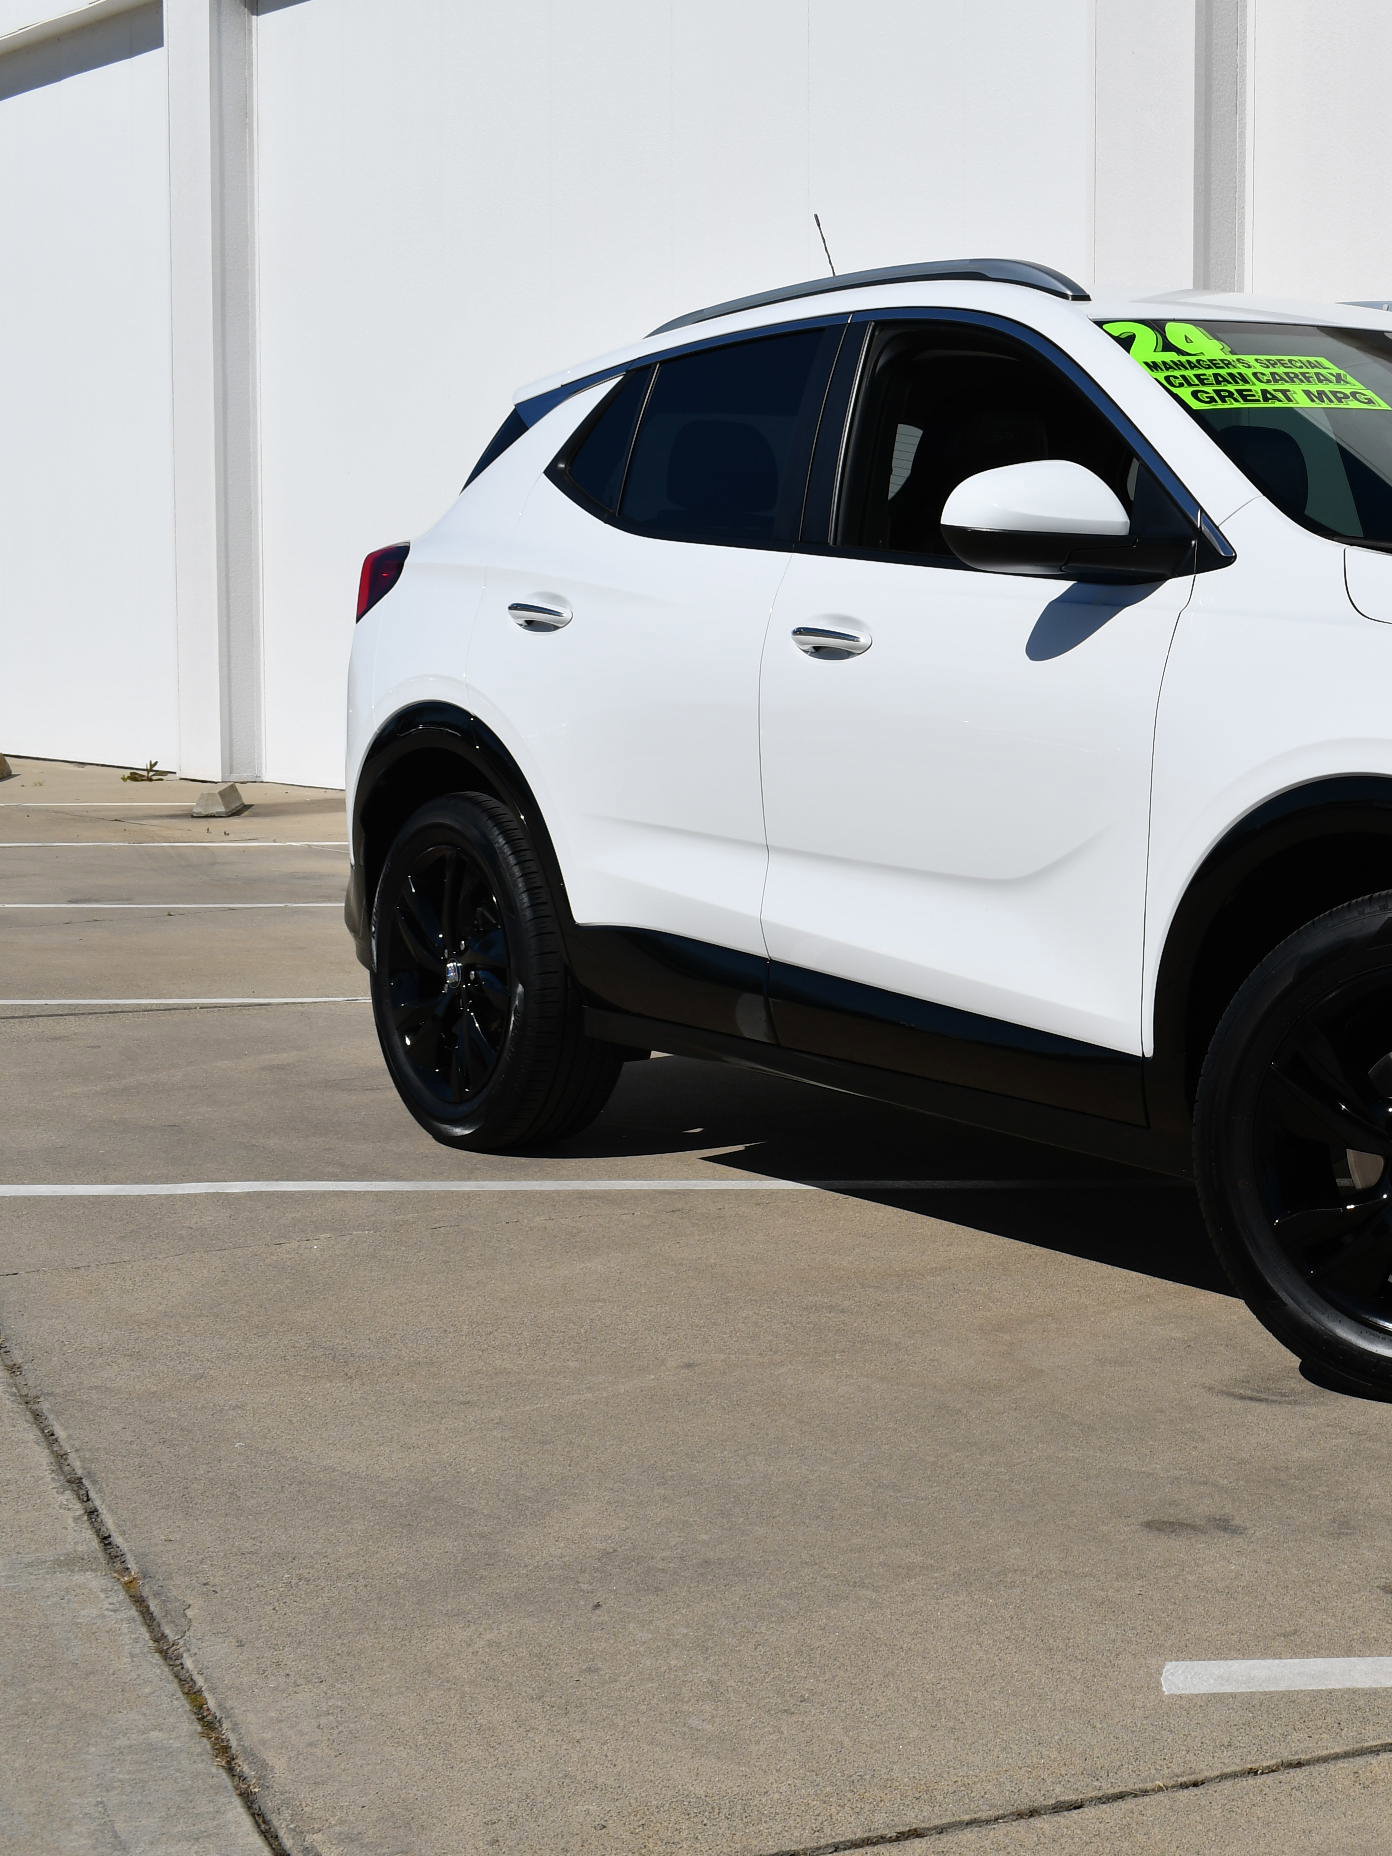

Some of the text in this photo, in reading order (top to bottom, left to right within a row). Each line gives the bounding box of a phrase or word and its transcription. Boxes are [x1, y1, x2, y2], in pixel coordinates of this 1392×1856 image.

[1143, 358, 1331, 373] MANAGER'S SPECIAL
[1164, 371, 1351, 388] CLEAN CARFAX
[1191, 389, 1377, 406] GREAT MPG
